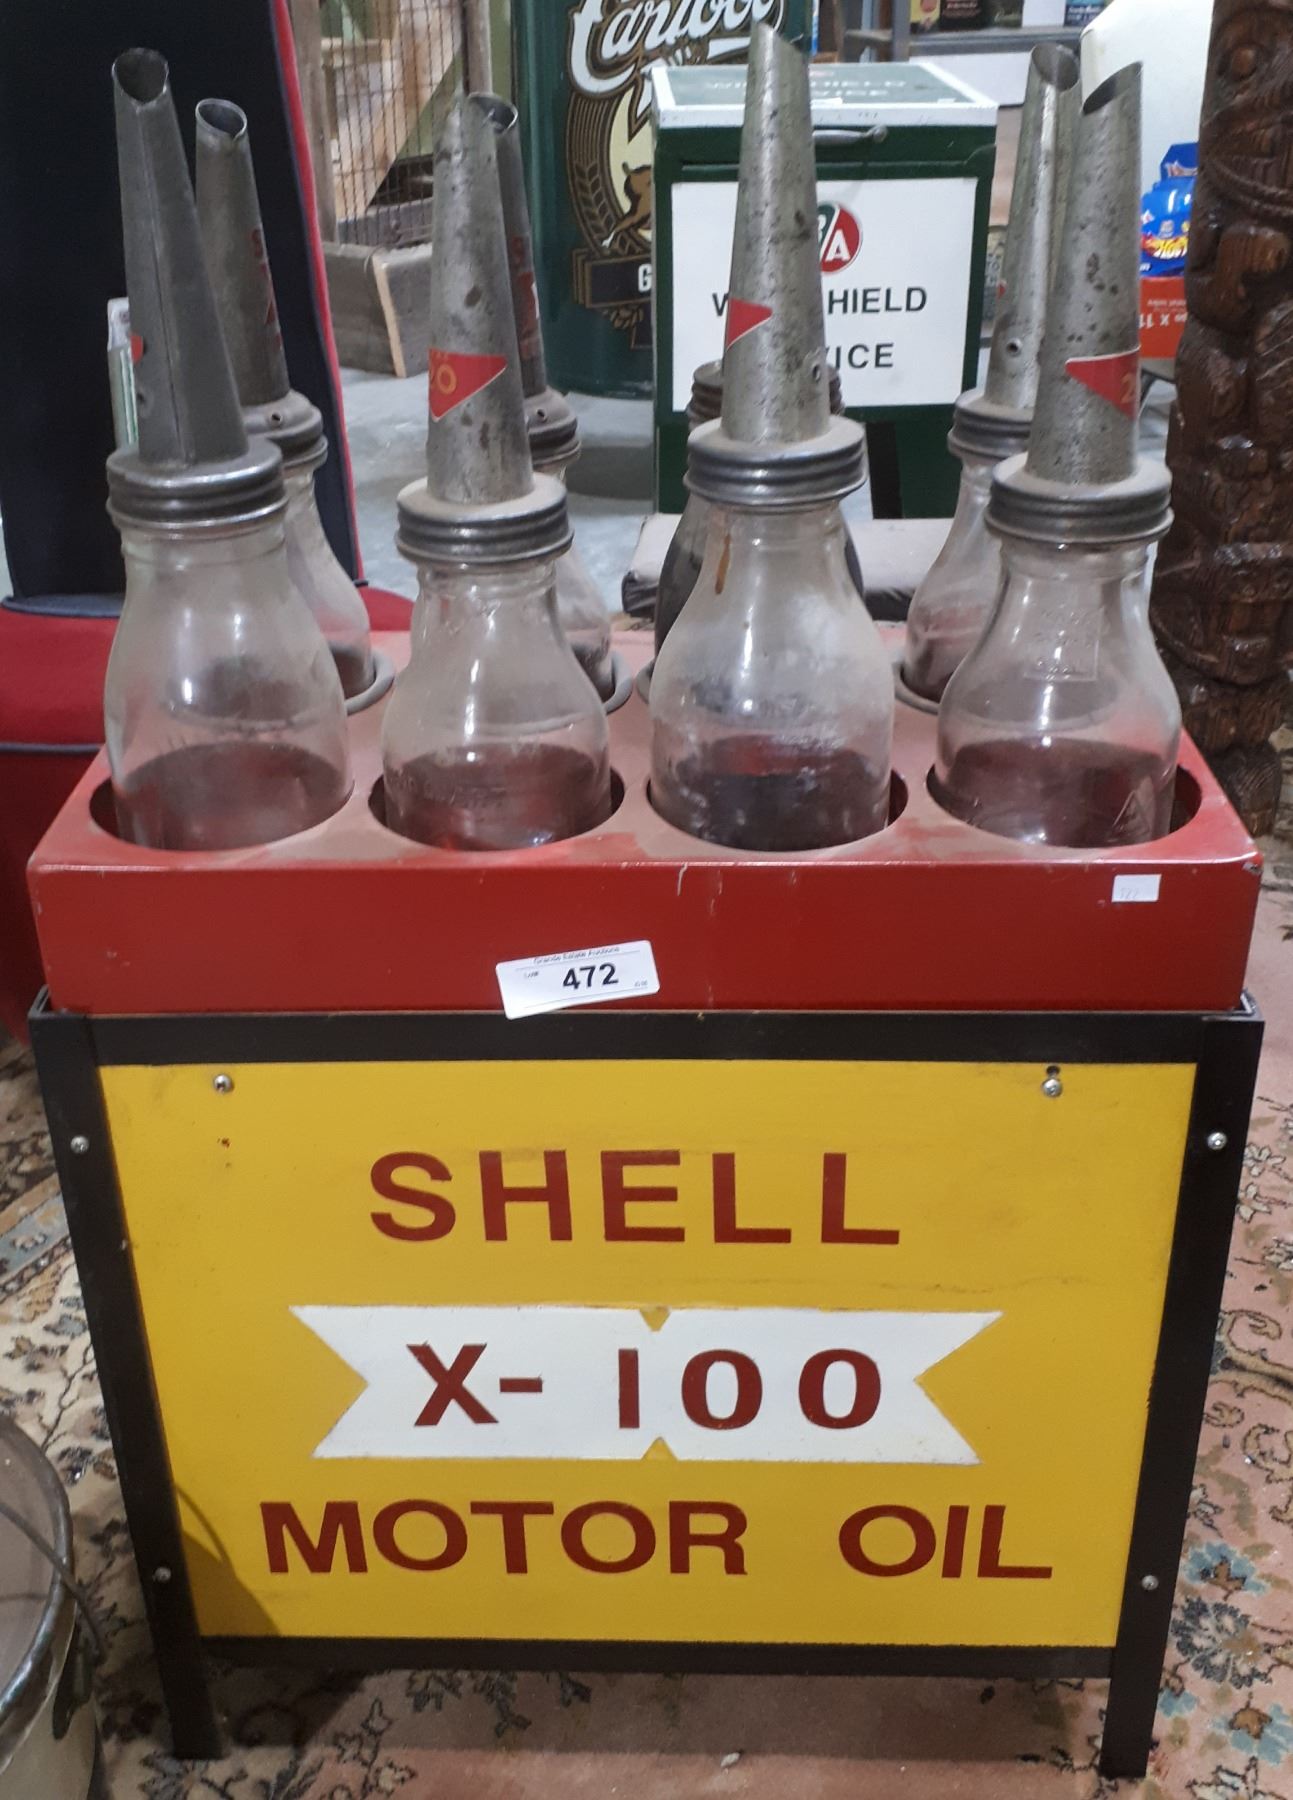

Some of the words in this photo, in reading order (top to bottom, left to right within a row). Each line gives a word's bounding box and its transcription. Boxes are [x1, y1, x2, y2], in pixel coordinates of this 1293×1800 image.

[562, 962, 619, 990] 472
[370, 1149, 900, 1245] SHELL
[259, 1498, 748, 1576] MOTOR
[838, 1504, 1053, 1579] OIL
